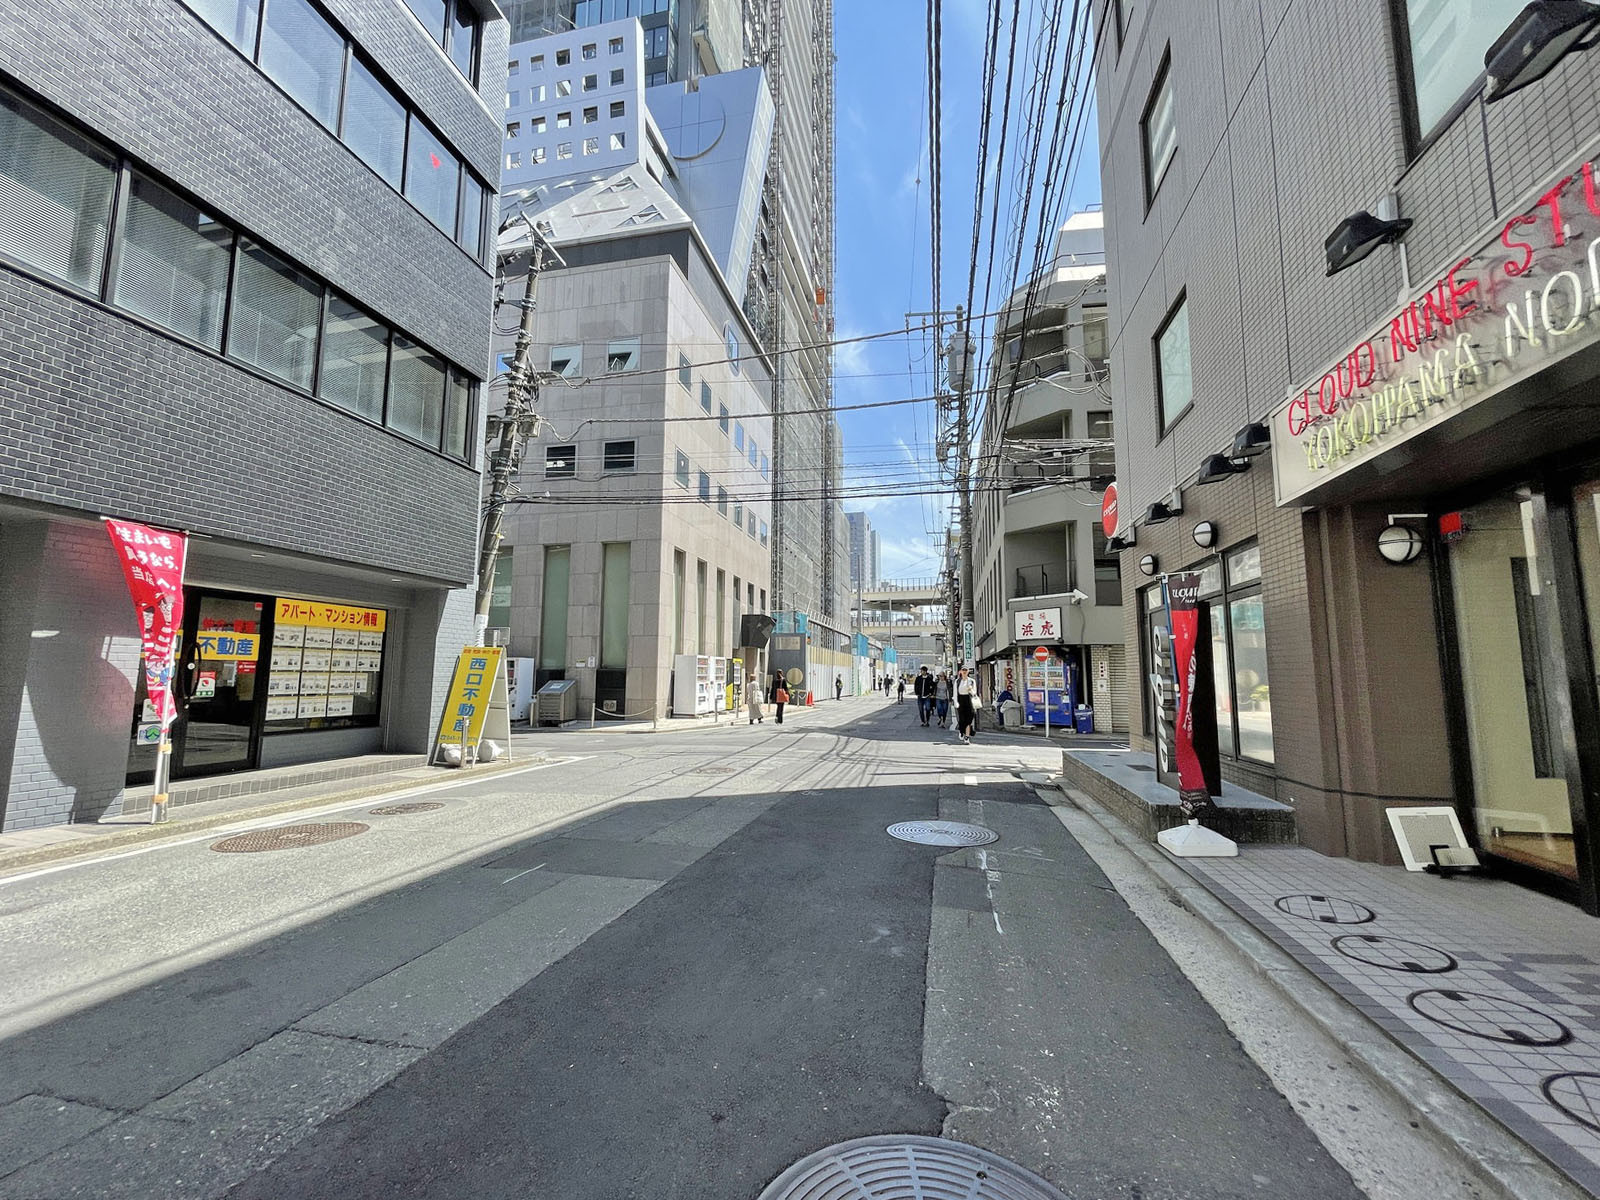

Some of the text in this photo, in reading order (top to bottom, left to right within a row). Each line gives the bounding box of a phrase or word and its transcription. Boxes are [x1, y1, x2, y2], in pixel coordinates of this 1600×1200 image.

[1288, 341, 1375, 436] CLOUD
[1390, 257, 1479, 362] NINE
[1301, 332, 1481, 471] YOKOHAMA
[198, 636, 254, 656] 不動産
[281, 603, 378, 627] アパート・マンション情報
[1021, 620, 1054, 637] 浜虎
[1149, 625, 1168, 773] CLOUD
